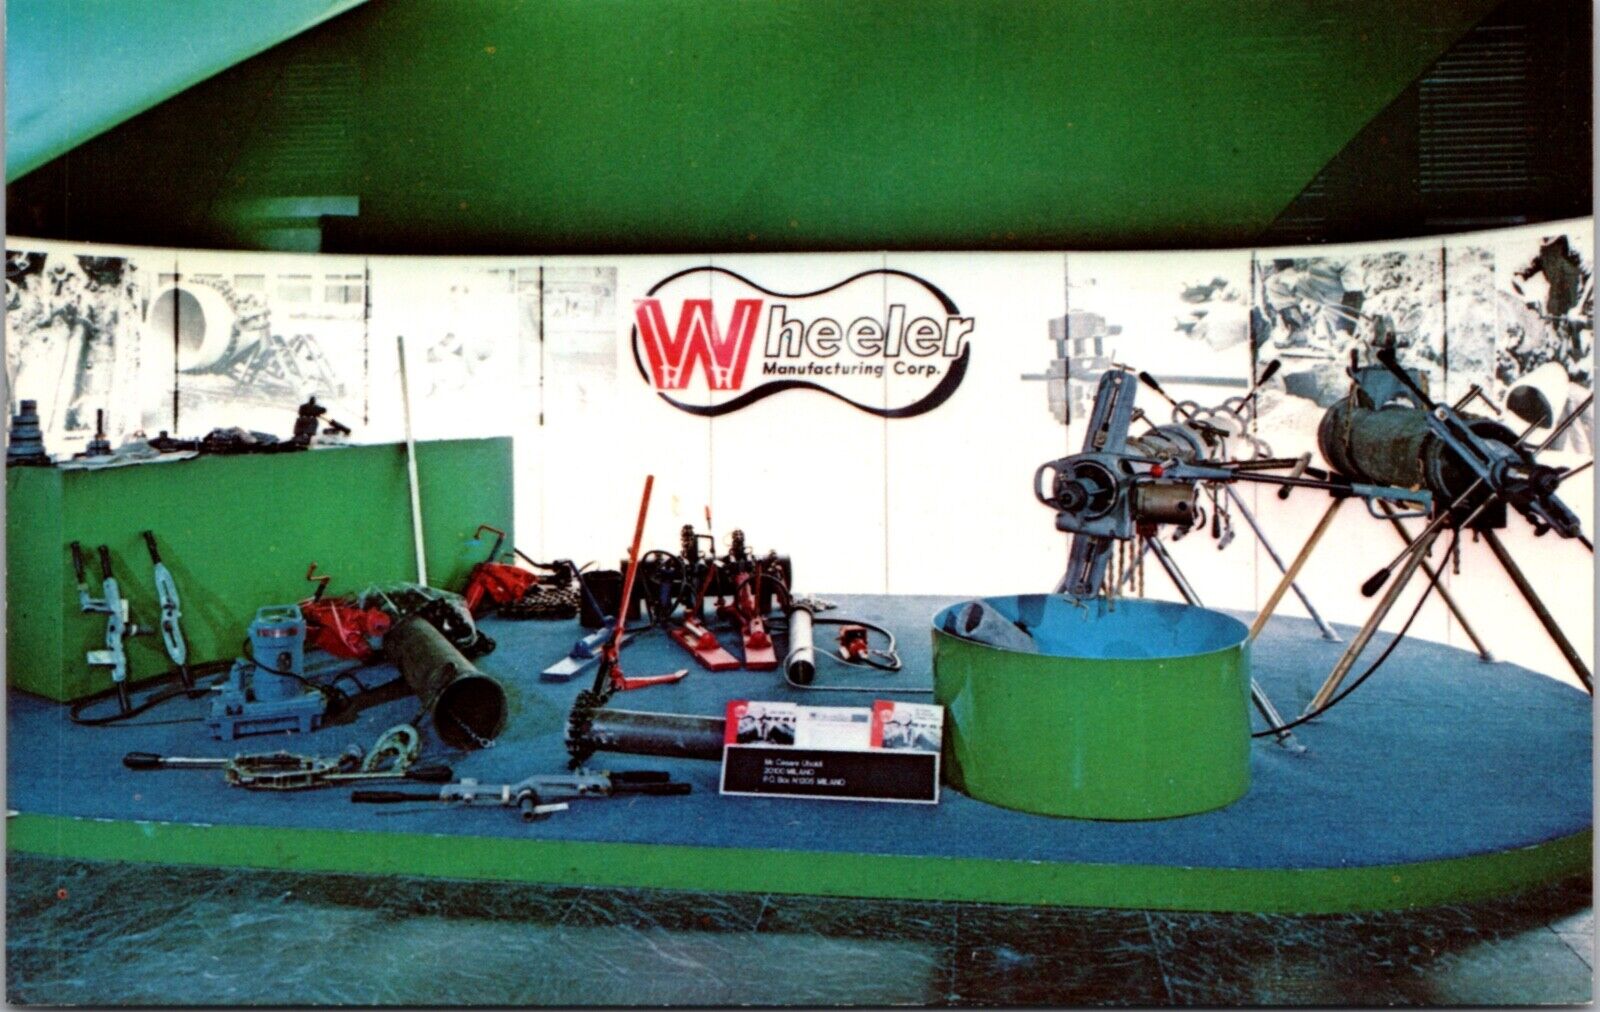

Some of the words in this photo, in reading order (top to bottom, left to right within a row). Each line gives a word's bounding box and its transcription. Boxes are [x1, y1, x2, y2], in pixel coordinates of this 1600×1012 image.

[634, 298, 975, 390] Wheeler
[763, 361, 885, 378] Manufacturing
[893, 362, 941, 377] Corp.
[786, 768, 815, 776] MILANO
[816, 778, 846, 786] MILANO
